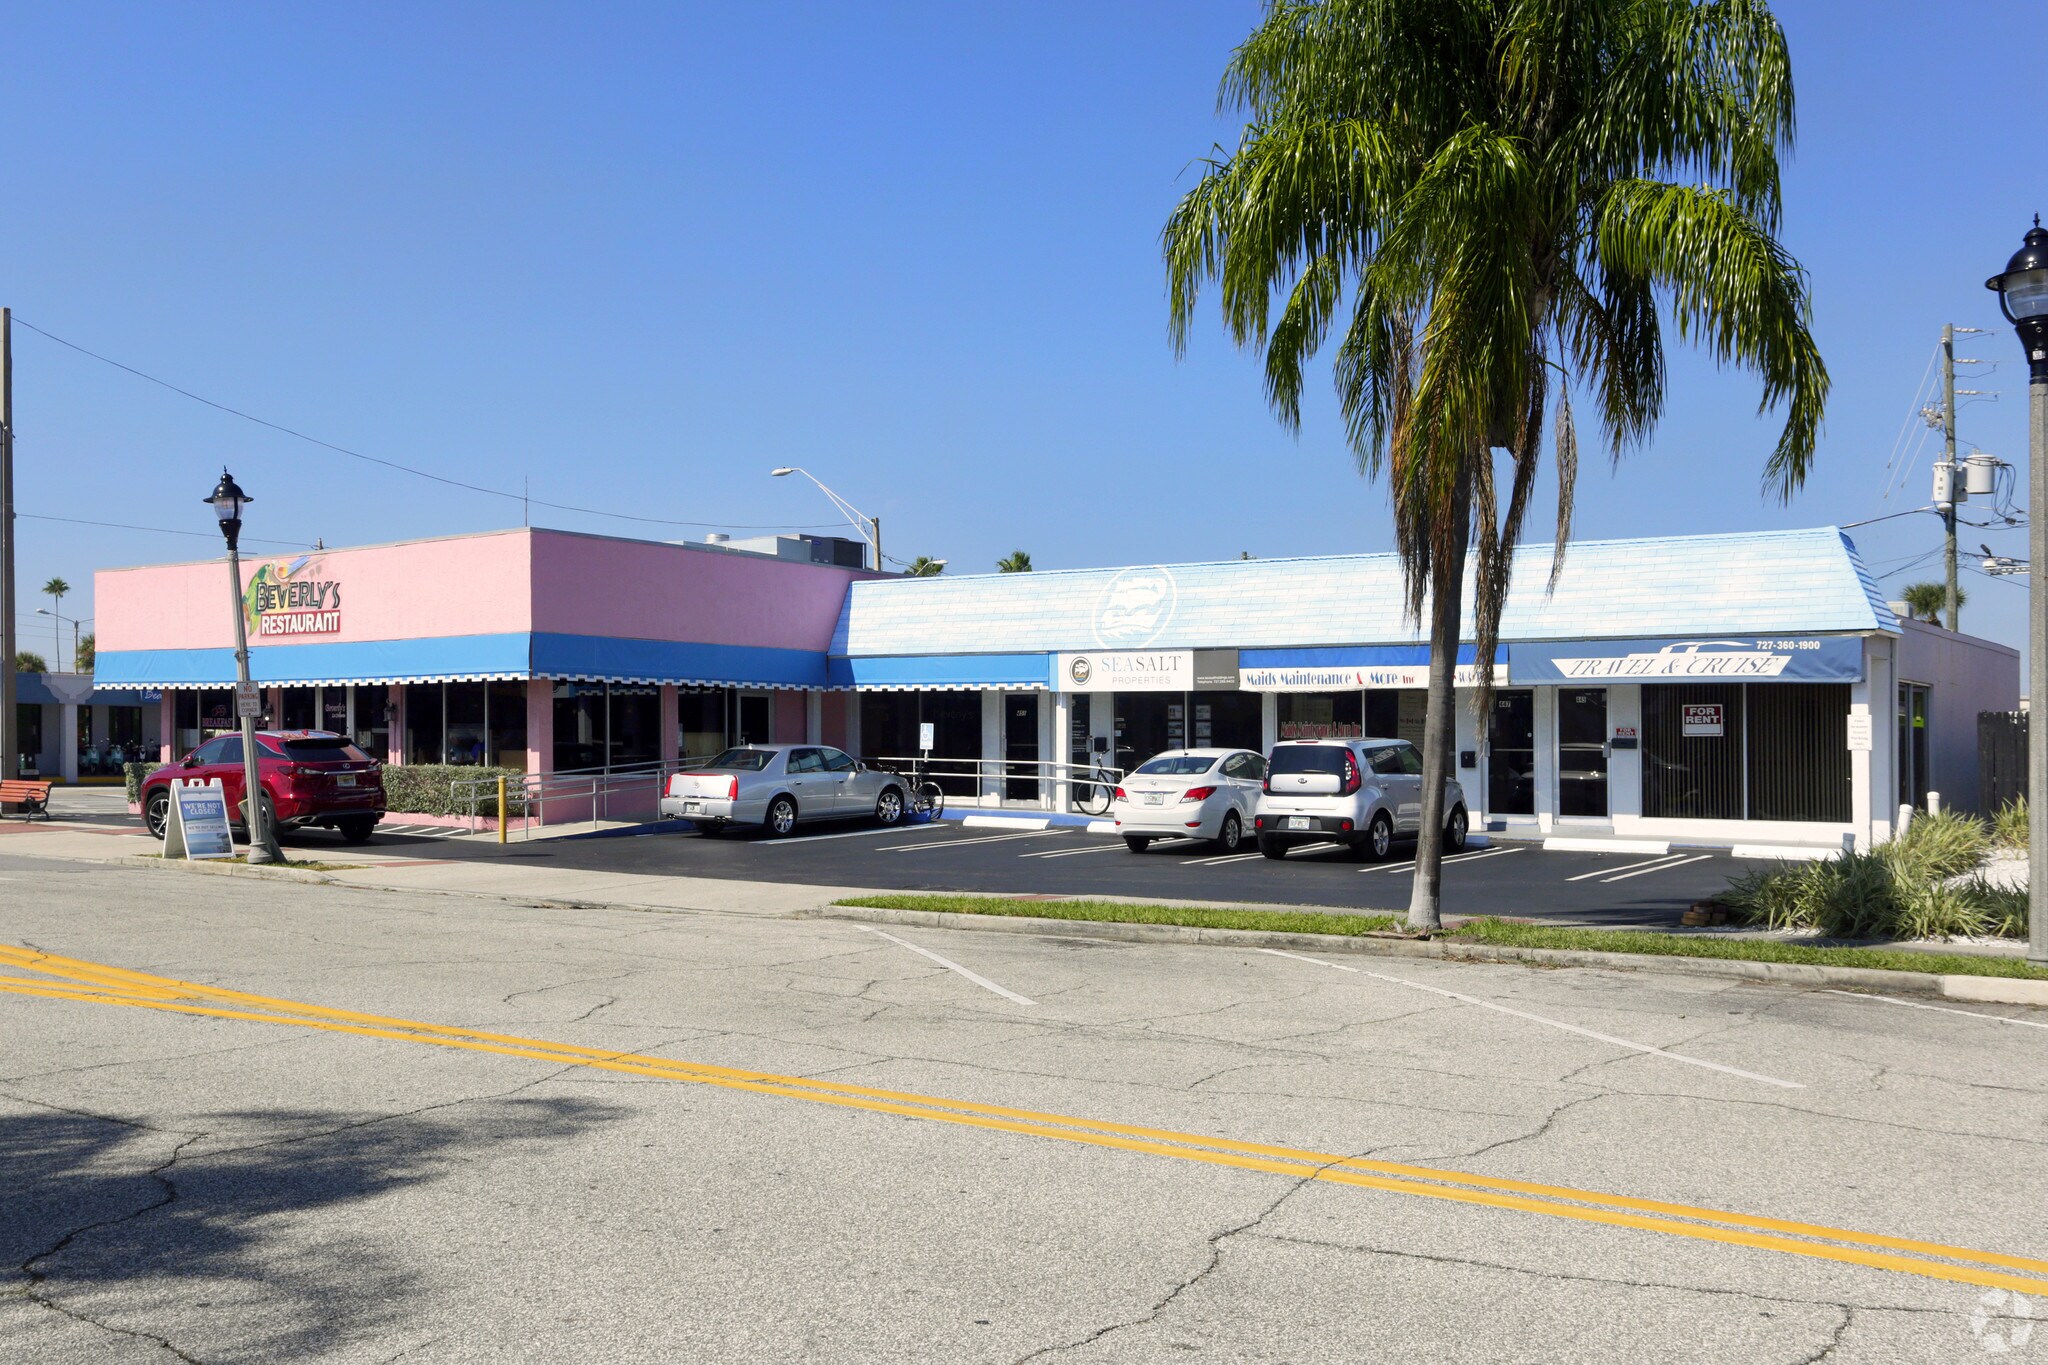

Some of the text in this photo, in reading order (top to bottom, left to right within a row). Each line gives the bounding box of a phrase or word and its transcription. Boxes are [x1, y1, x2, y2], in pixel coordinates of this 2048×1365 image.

[256, 581, 341, 611] BEVERLY'S
[261, 611, 340, 635] RESTAURANT
[1756, 640, 1821, 650] 727-360-1900
[1101, 655, 1182, 672] SEASALT
[1569, 655, 1779, 675] TRAVEL & CRUISE
[1112, 676, 1171, 685] PROPERTIES
[1246, 670, 1277, 686] Maids
[1280, 670, 1352, 686] Maintenance
[1370, 672, 1398, 685] More
[239, 692, 259, 700] PARKING
[1689, 707, 1716, 716] FOR
[1685, 715, 1720, 724] RENT
